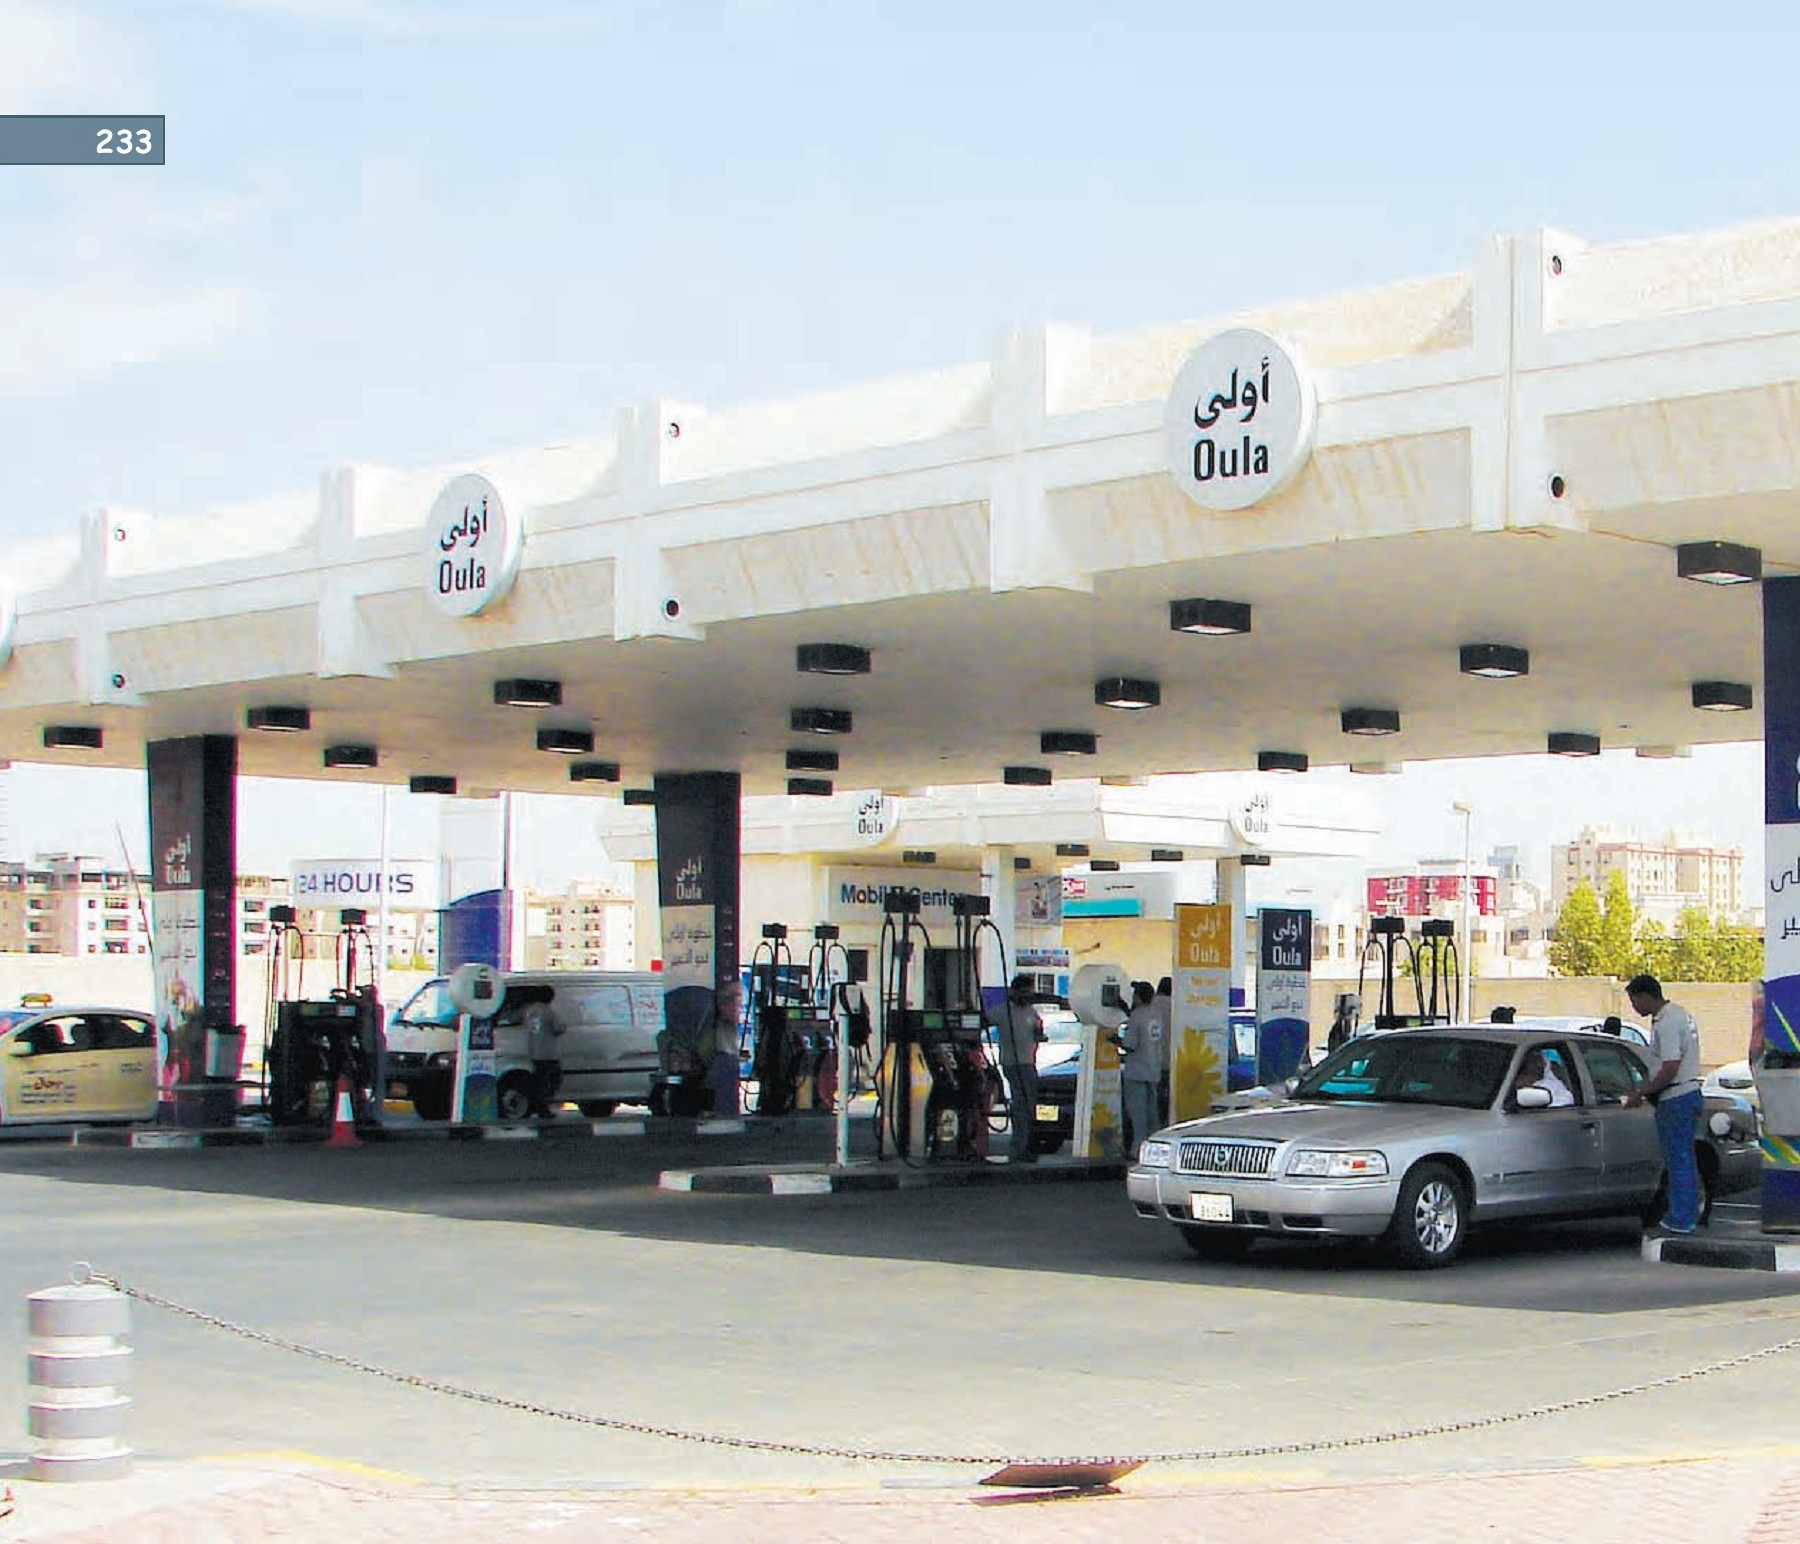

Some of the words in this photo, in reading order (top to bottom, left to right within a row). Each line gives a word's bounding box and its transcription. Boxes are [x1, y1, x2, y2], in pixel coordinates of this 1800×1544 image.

[1194, 356, 1270, 429] أولى
[1193, 435, 1269, 481] Oula
[440, 495, 488, 552] أولى
[439, 557, 486, 594] Oula
[858, 818, 883, 834] Oula
[1244, 816, 1269, 833] Oula
[298, 873, 318, 894] 24
[323, 872, 414, 893] HOURS
[676, 882, 702, 900] Oula
[840, 884, 892, 905] Mobil
[908, 886, 957, 907] Cente
[1191, 942, 1220, 964] Oula
[1272, 945, 1302, 966] Oula
